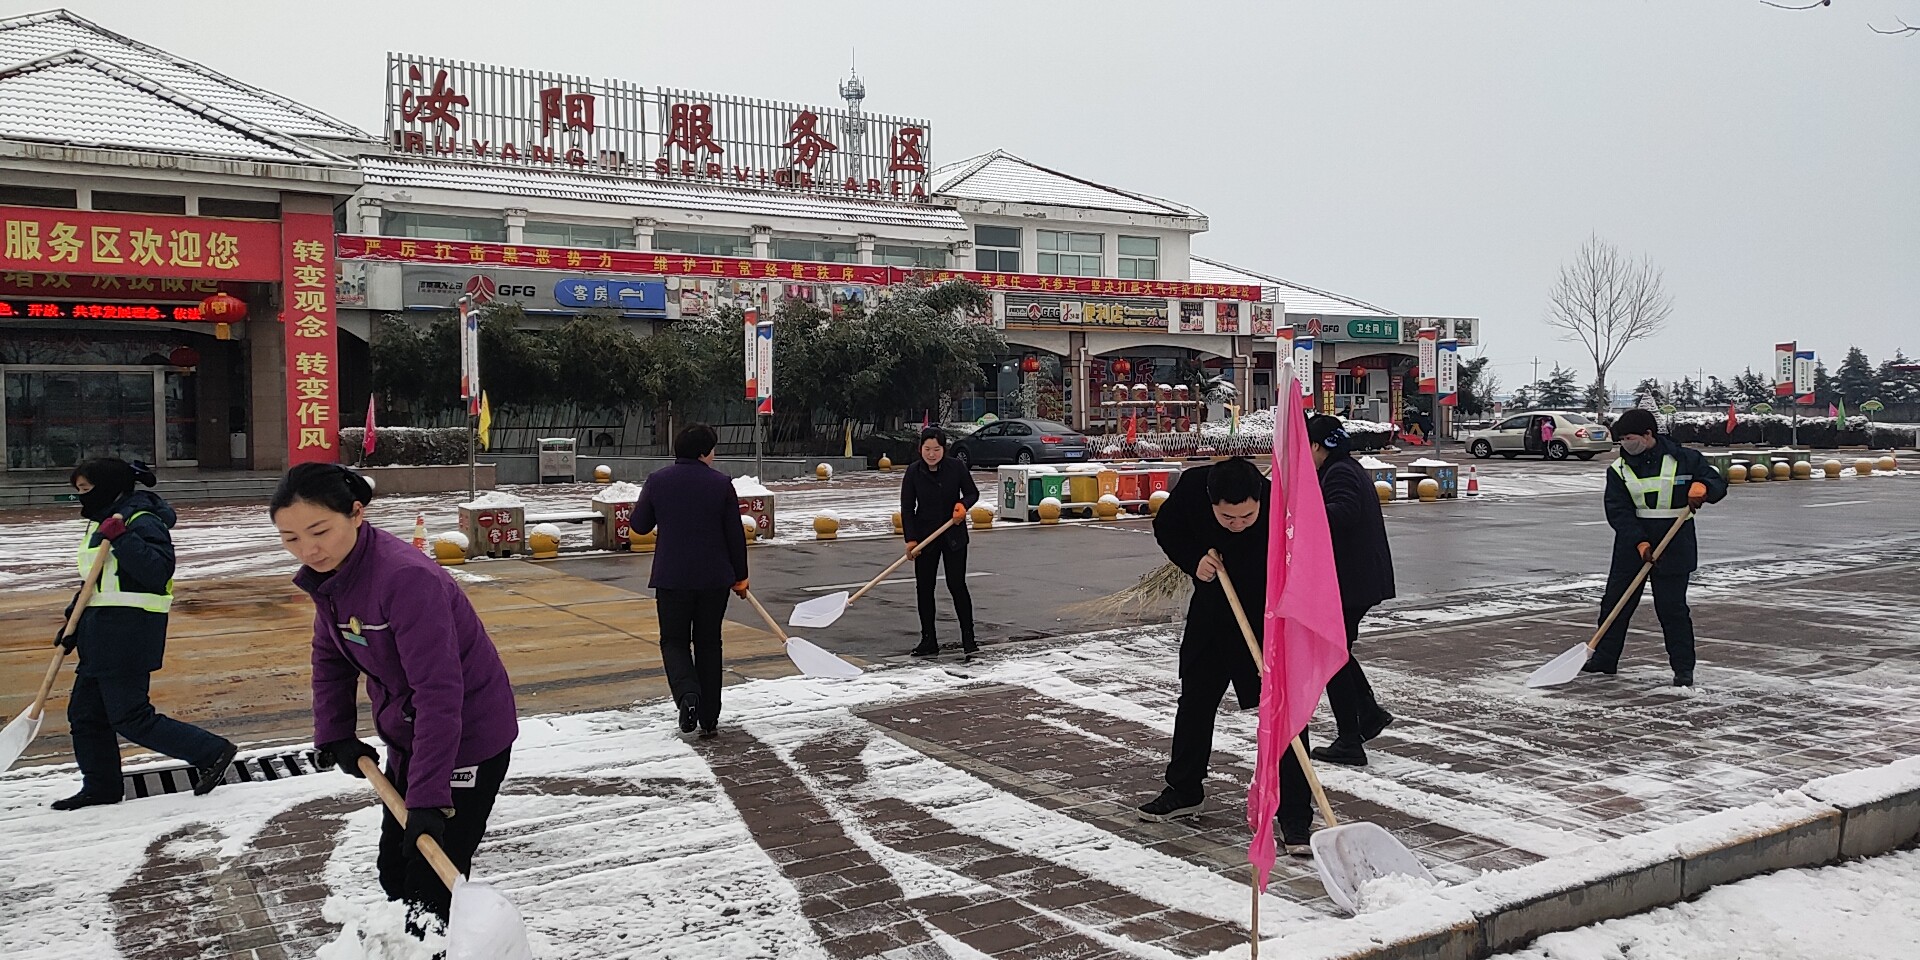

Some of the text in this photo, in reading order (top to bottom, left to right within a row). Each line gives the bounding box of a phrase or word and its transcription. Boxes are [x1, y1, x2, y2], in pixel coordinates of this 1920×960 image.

[403, 65, 925, 174] 汝阳服务区
[404, 132, 926, 197] RUYANG SERVICE AREA
[4, 219, 241, 270] 服务区欢迎您
[652, 254, 855, 283] 维护正常经营秩序
[498, 284, 536, 297] GFG
[573, 284, 608, 302] 客房
[1042, 306, 1060, 318] GFG
[1081, 302, 1124, 324] 便利店
[292, 239, 331, 450] 转变观念 转变作风
[738, 499, 764, 511] 一流
[479, 511, 512, 524] 一流
[615, 506, 630, 539] 欢迎
[490, 529, 521, 543] 管理
